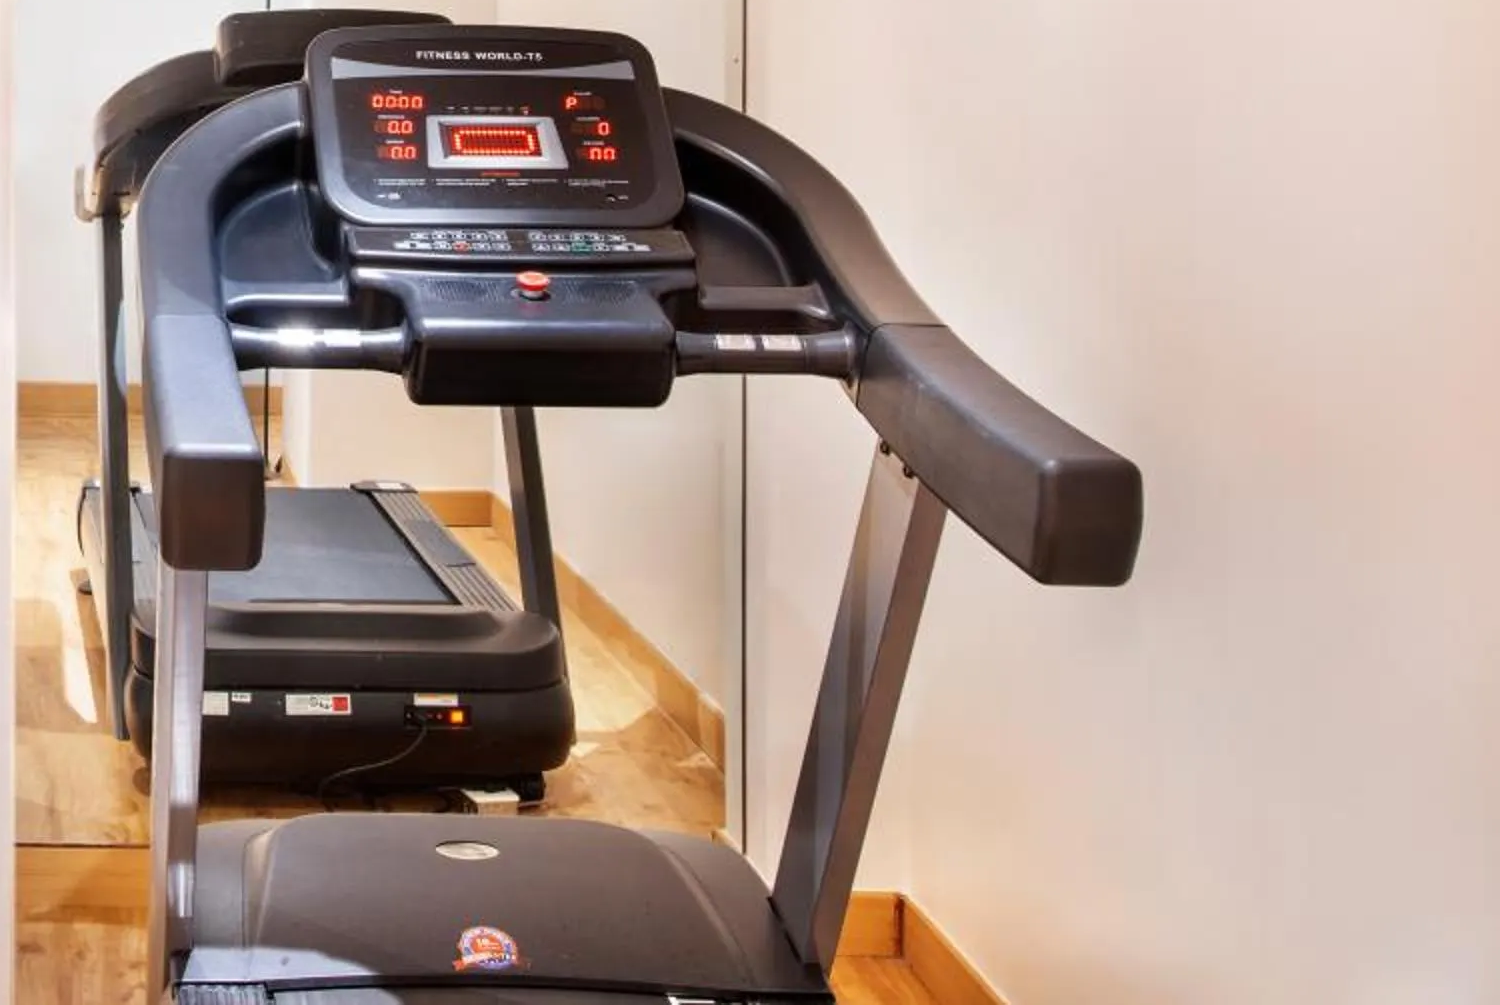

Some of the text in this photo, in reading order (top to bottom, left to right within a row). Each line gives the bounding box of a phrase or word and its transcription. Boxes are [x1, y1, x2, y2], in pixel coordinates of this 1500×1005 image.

[415, 50, 470, 60] FITNESS
[565, 96, 577, 110] P
[598, 122, 610, 136] 0
